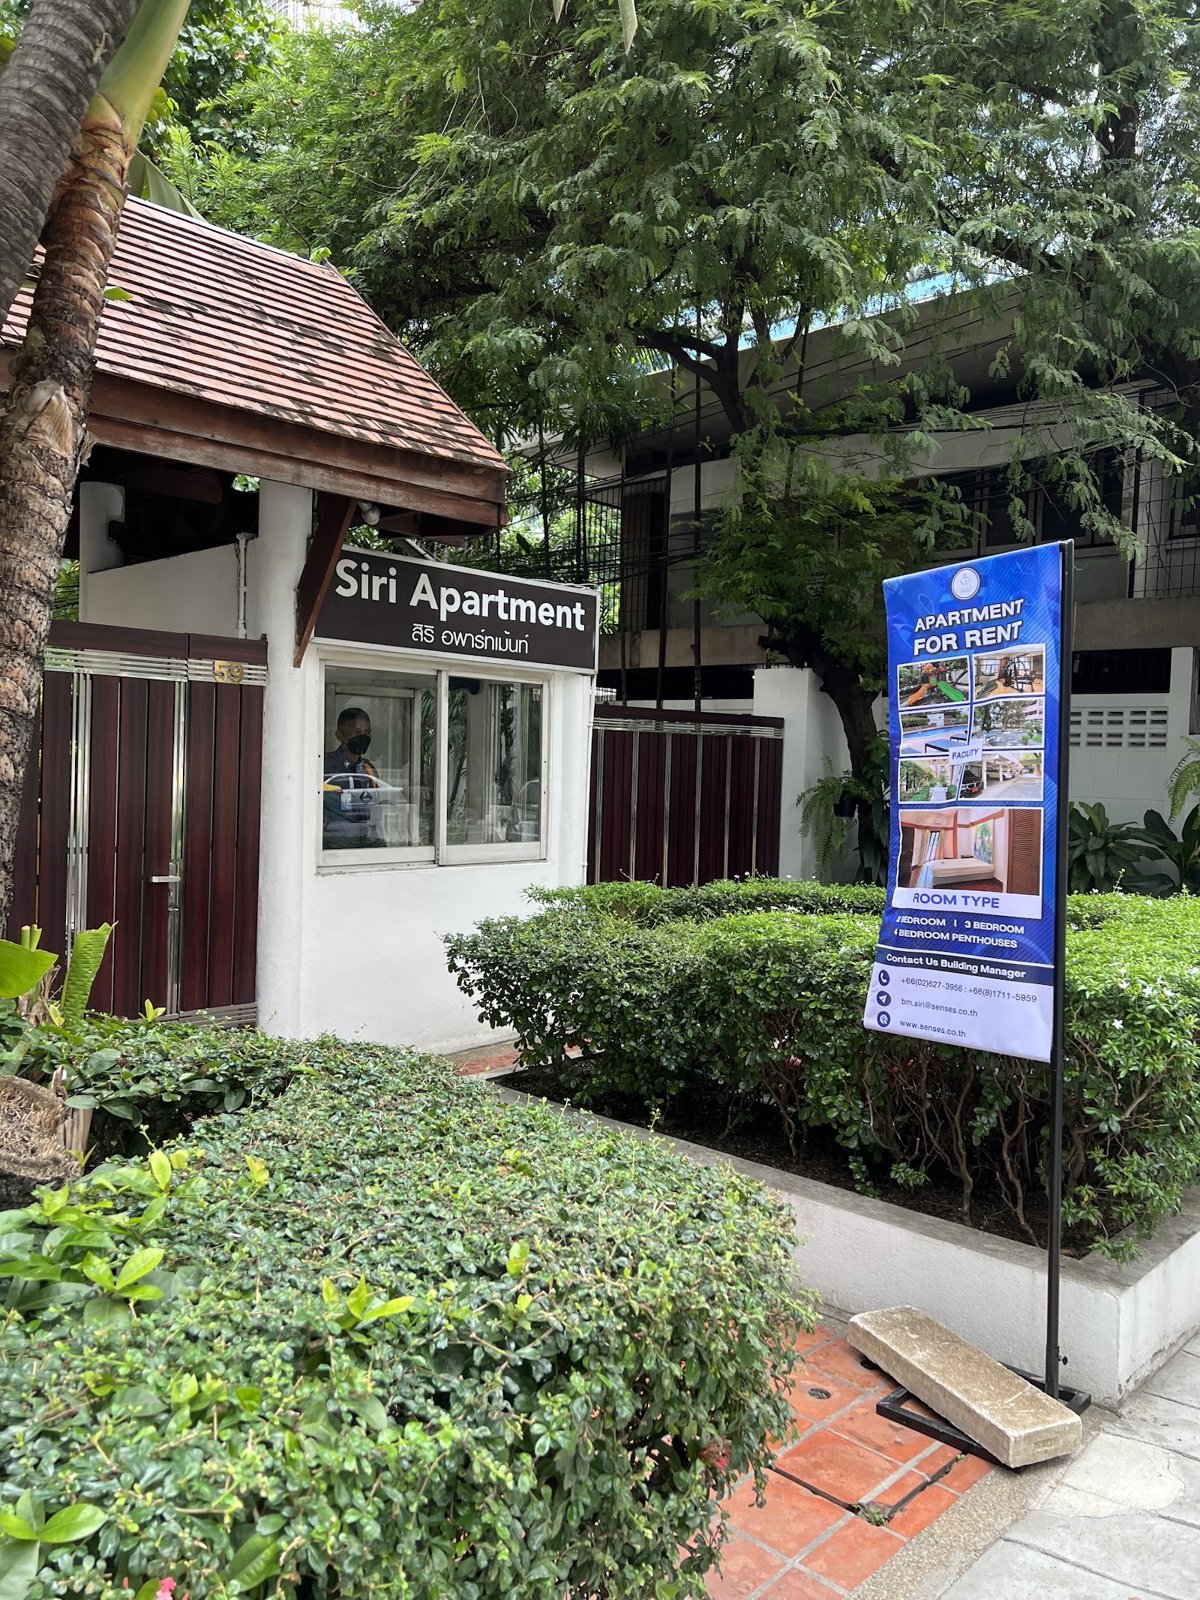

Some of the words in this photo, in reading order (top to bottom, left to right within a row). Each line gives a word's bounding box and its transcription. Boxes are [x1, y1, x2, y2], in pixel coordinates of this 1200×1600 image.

[334, 558, 398, 604] Siri
[409, 573, 586, 632] Apartment
[914, 598, 1025, 633] APARTMENT
[411, 623, 435, 644] สิริ
[441, 628, 530, 654] อพาร์ทเม้นท์
[913, 633, 958, 656] FOR
[965, 620, 1023, 648] RENT
[213, 660, 244, 685] 59
[951, 747, 979, 760] FACILITY
[912, 893, 957, 906] ROOM
[962, 895, 1000, 909] TYPE
[898, 929, 950, 941] BEDROOM
[951, 933, 1018, 949] PENTHOUSES
[964, 920, 972, 930] 3
[973, 921, 1025, 935] BEDROOM
[886, 953, 924, 966] Contact
[925, 956, 939, 967] Us
[940, 958, 978, 974] Building
[980, 965, 1027, 980] Manager
[899, 1020, 967, 1038] www.senses.co.th
